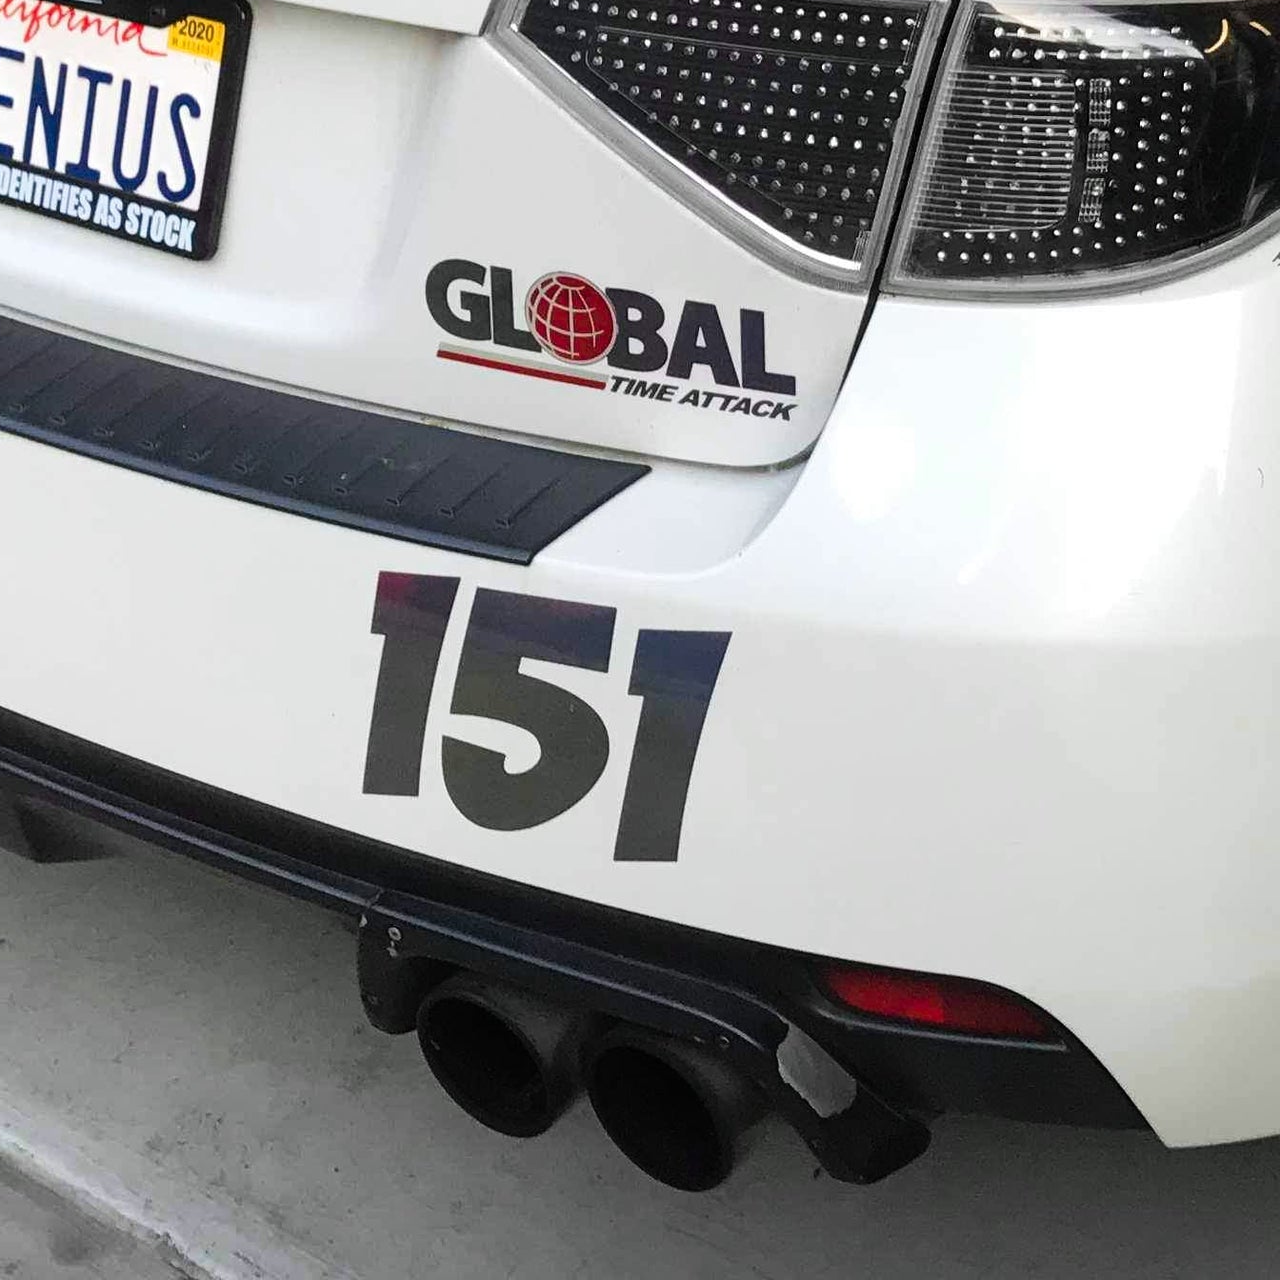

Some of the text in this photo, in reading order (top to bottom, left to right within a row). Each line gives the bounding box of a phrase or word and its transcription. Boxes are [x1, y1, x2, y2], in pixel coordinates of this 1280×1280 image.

[179, 19, 215, 43] 2020
[93, 193, 123, 230] AS
[125, 202, 196, 252] STOCK
[425, 258, 797, 396] GLOBAL
[608, 376, 799, 422] TIME ATTACK
[362, 570, 733, 863] 151
